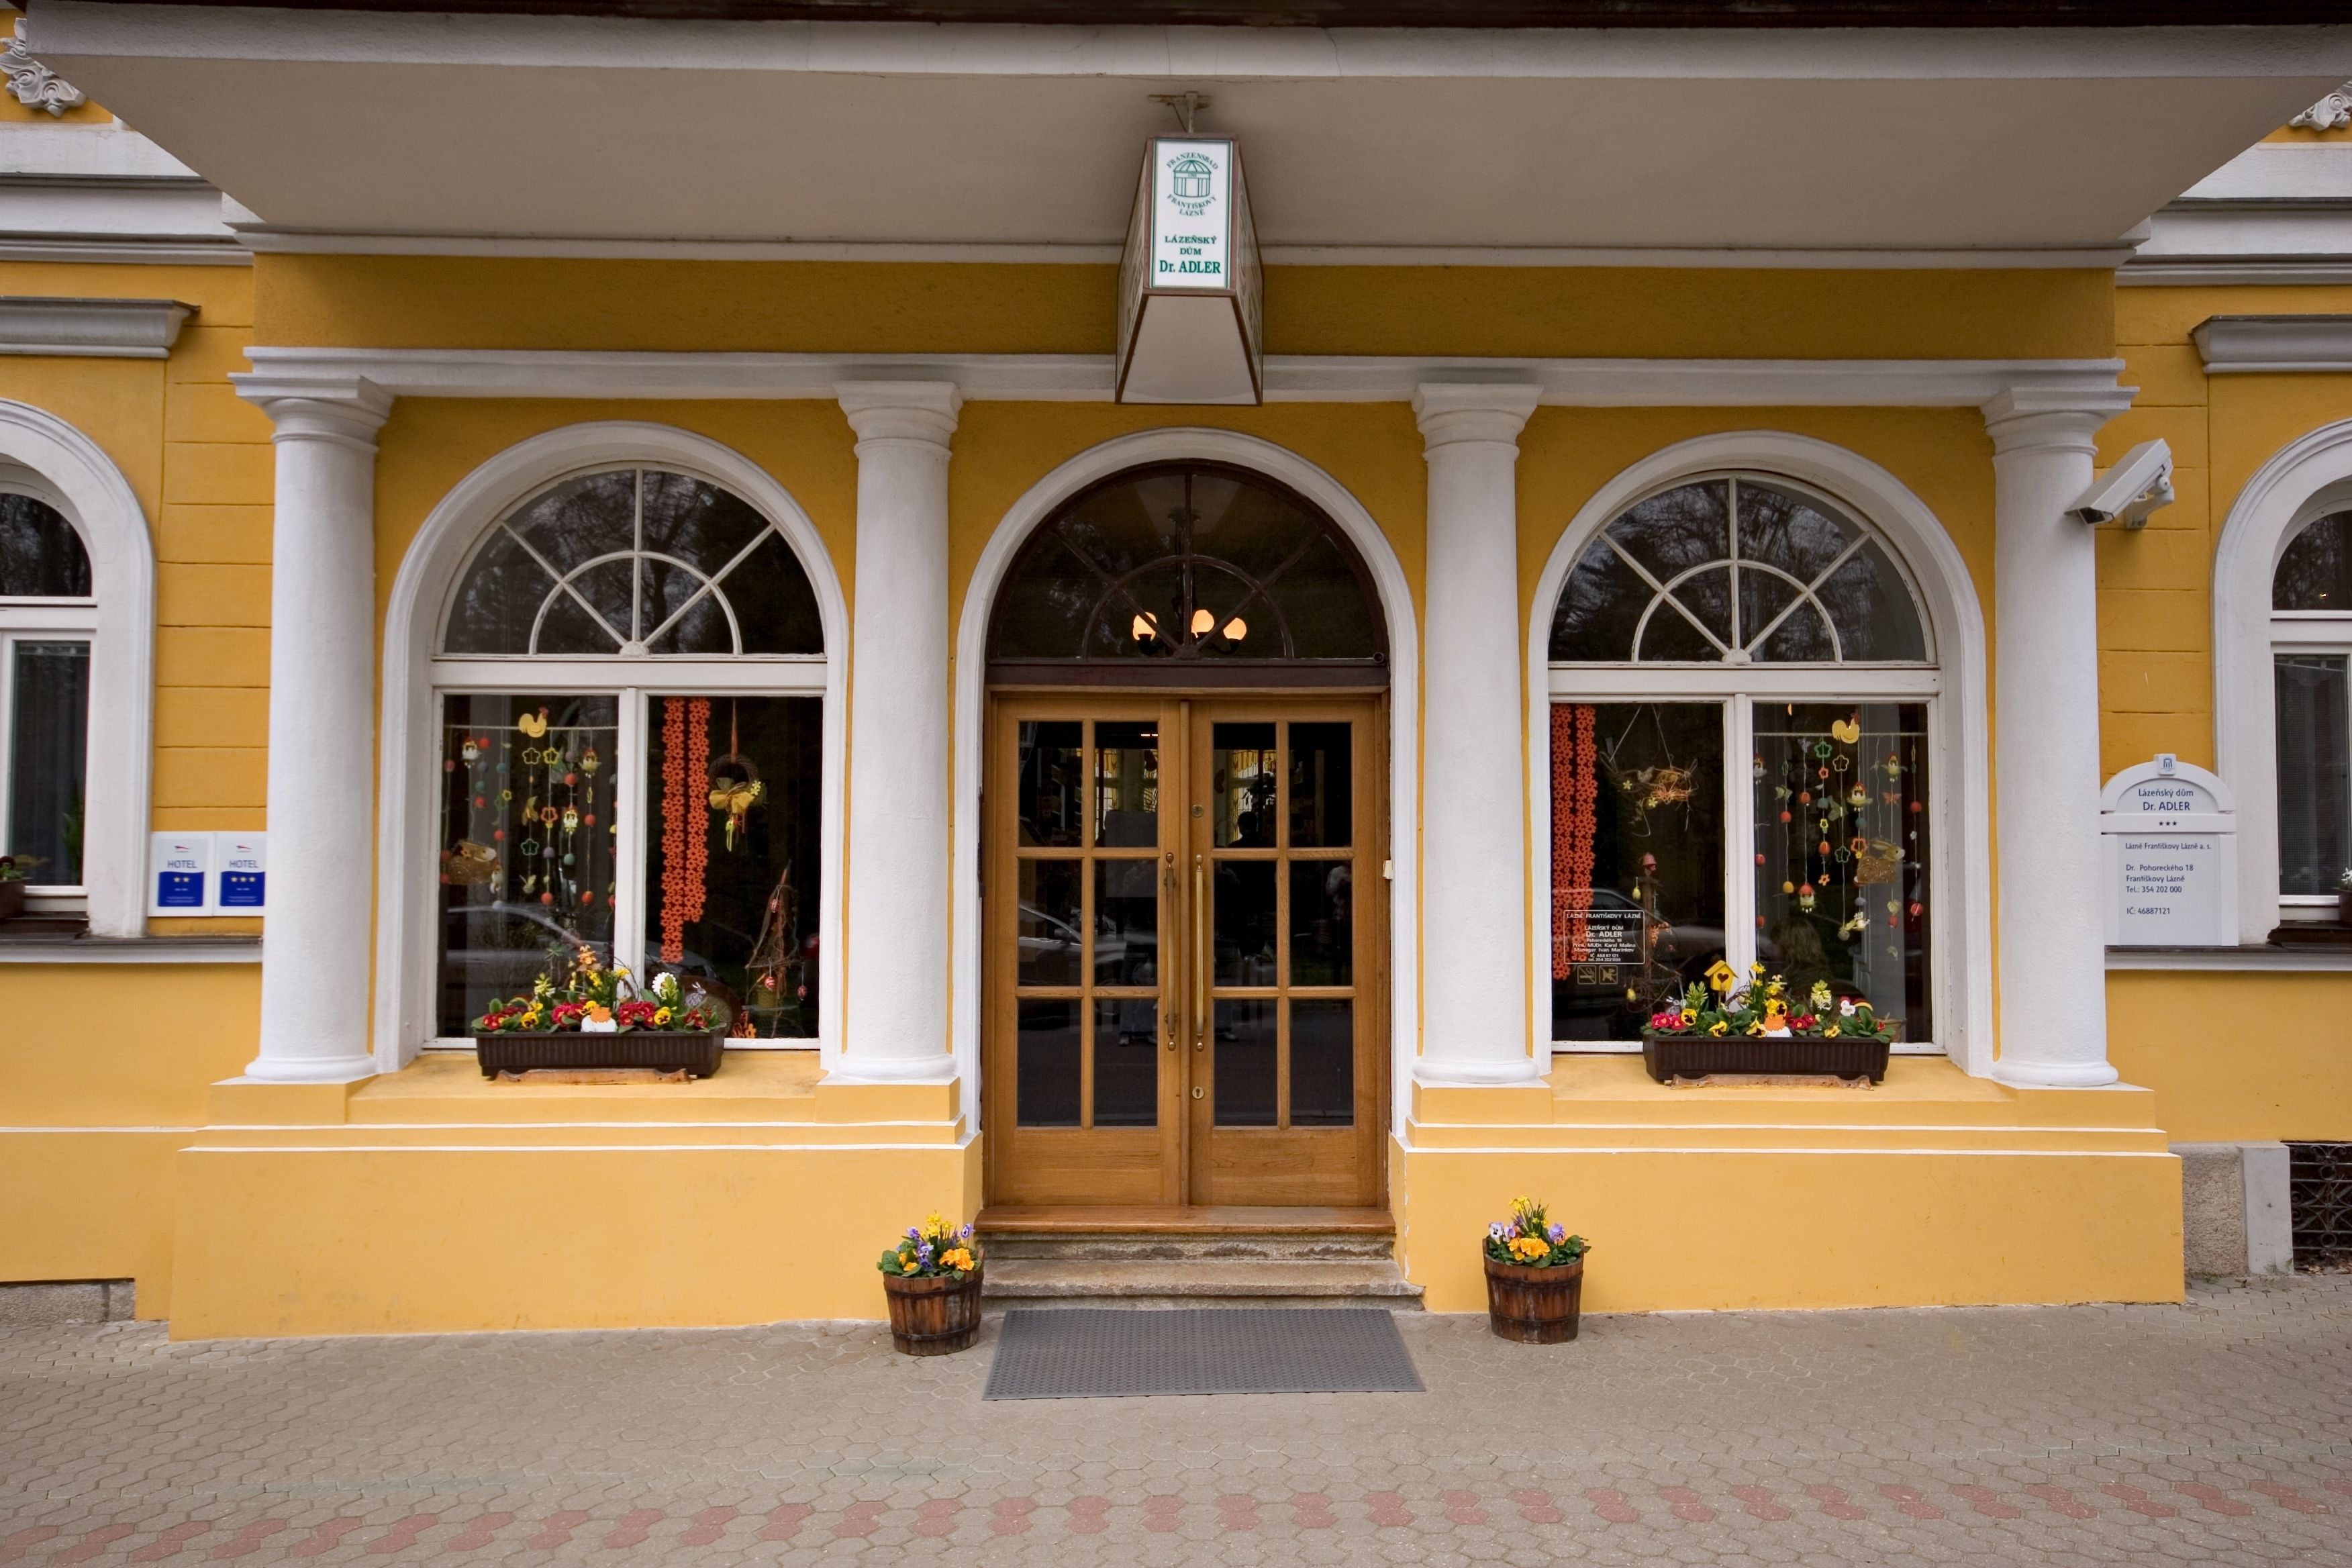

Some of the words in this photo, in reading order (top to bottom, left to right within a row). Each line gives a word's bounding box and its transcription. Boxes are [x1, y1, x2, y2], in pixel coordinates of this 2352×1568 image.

[1167, 152, 1218, 170] FRANZENSBAD
[1165, 235, 1217, 244] LÁZEŇSKÝ
[1159, 260, 1175, 273] Dr.
[1178, 260, 1221, 273] ADLER
[2139, 789, 2173, 798] Lázeňský
[2175, 789, 2194, 797] dům
[2143, 802, 2156, 811] Dr.
[2159, 801, 2190, 811] ADLER
[2144, 842, 2179, 851] Františkovy
[168, 860, 197, 869] HOTEL
[229, 860, 258, 869] HOTEL
[2126, 875, 2165, 883] Františkovy
